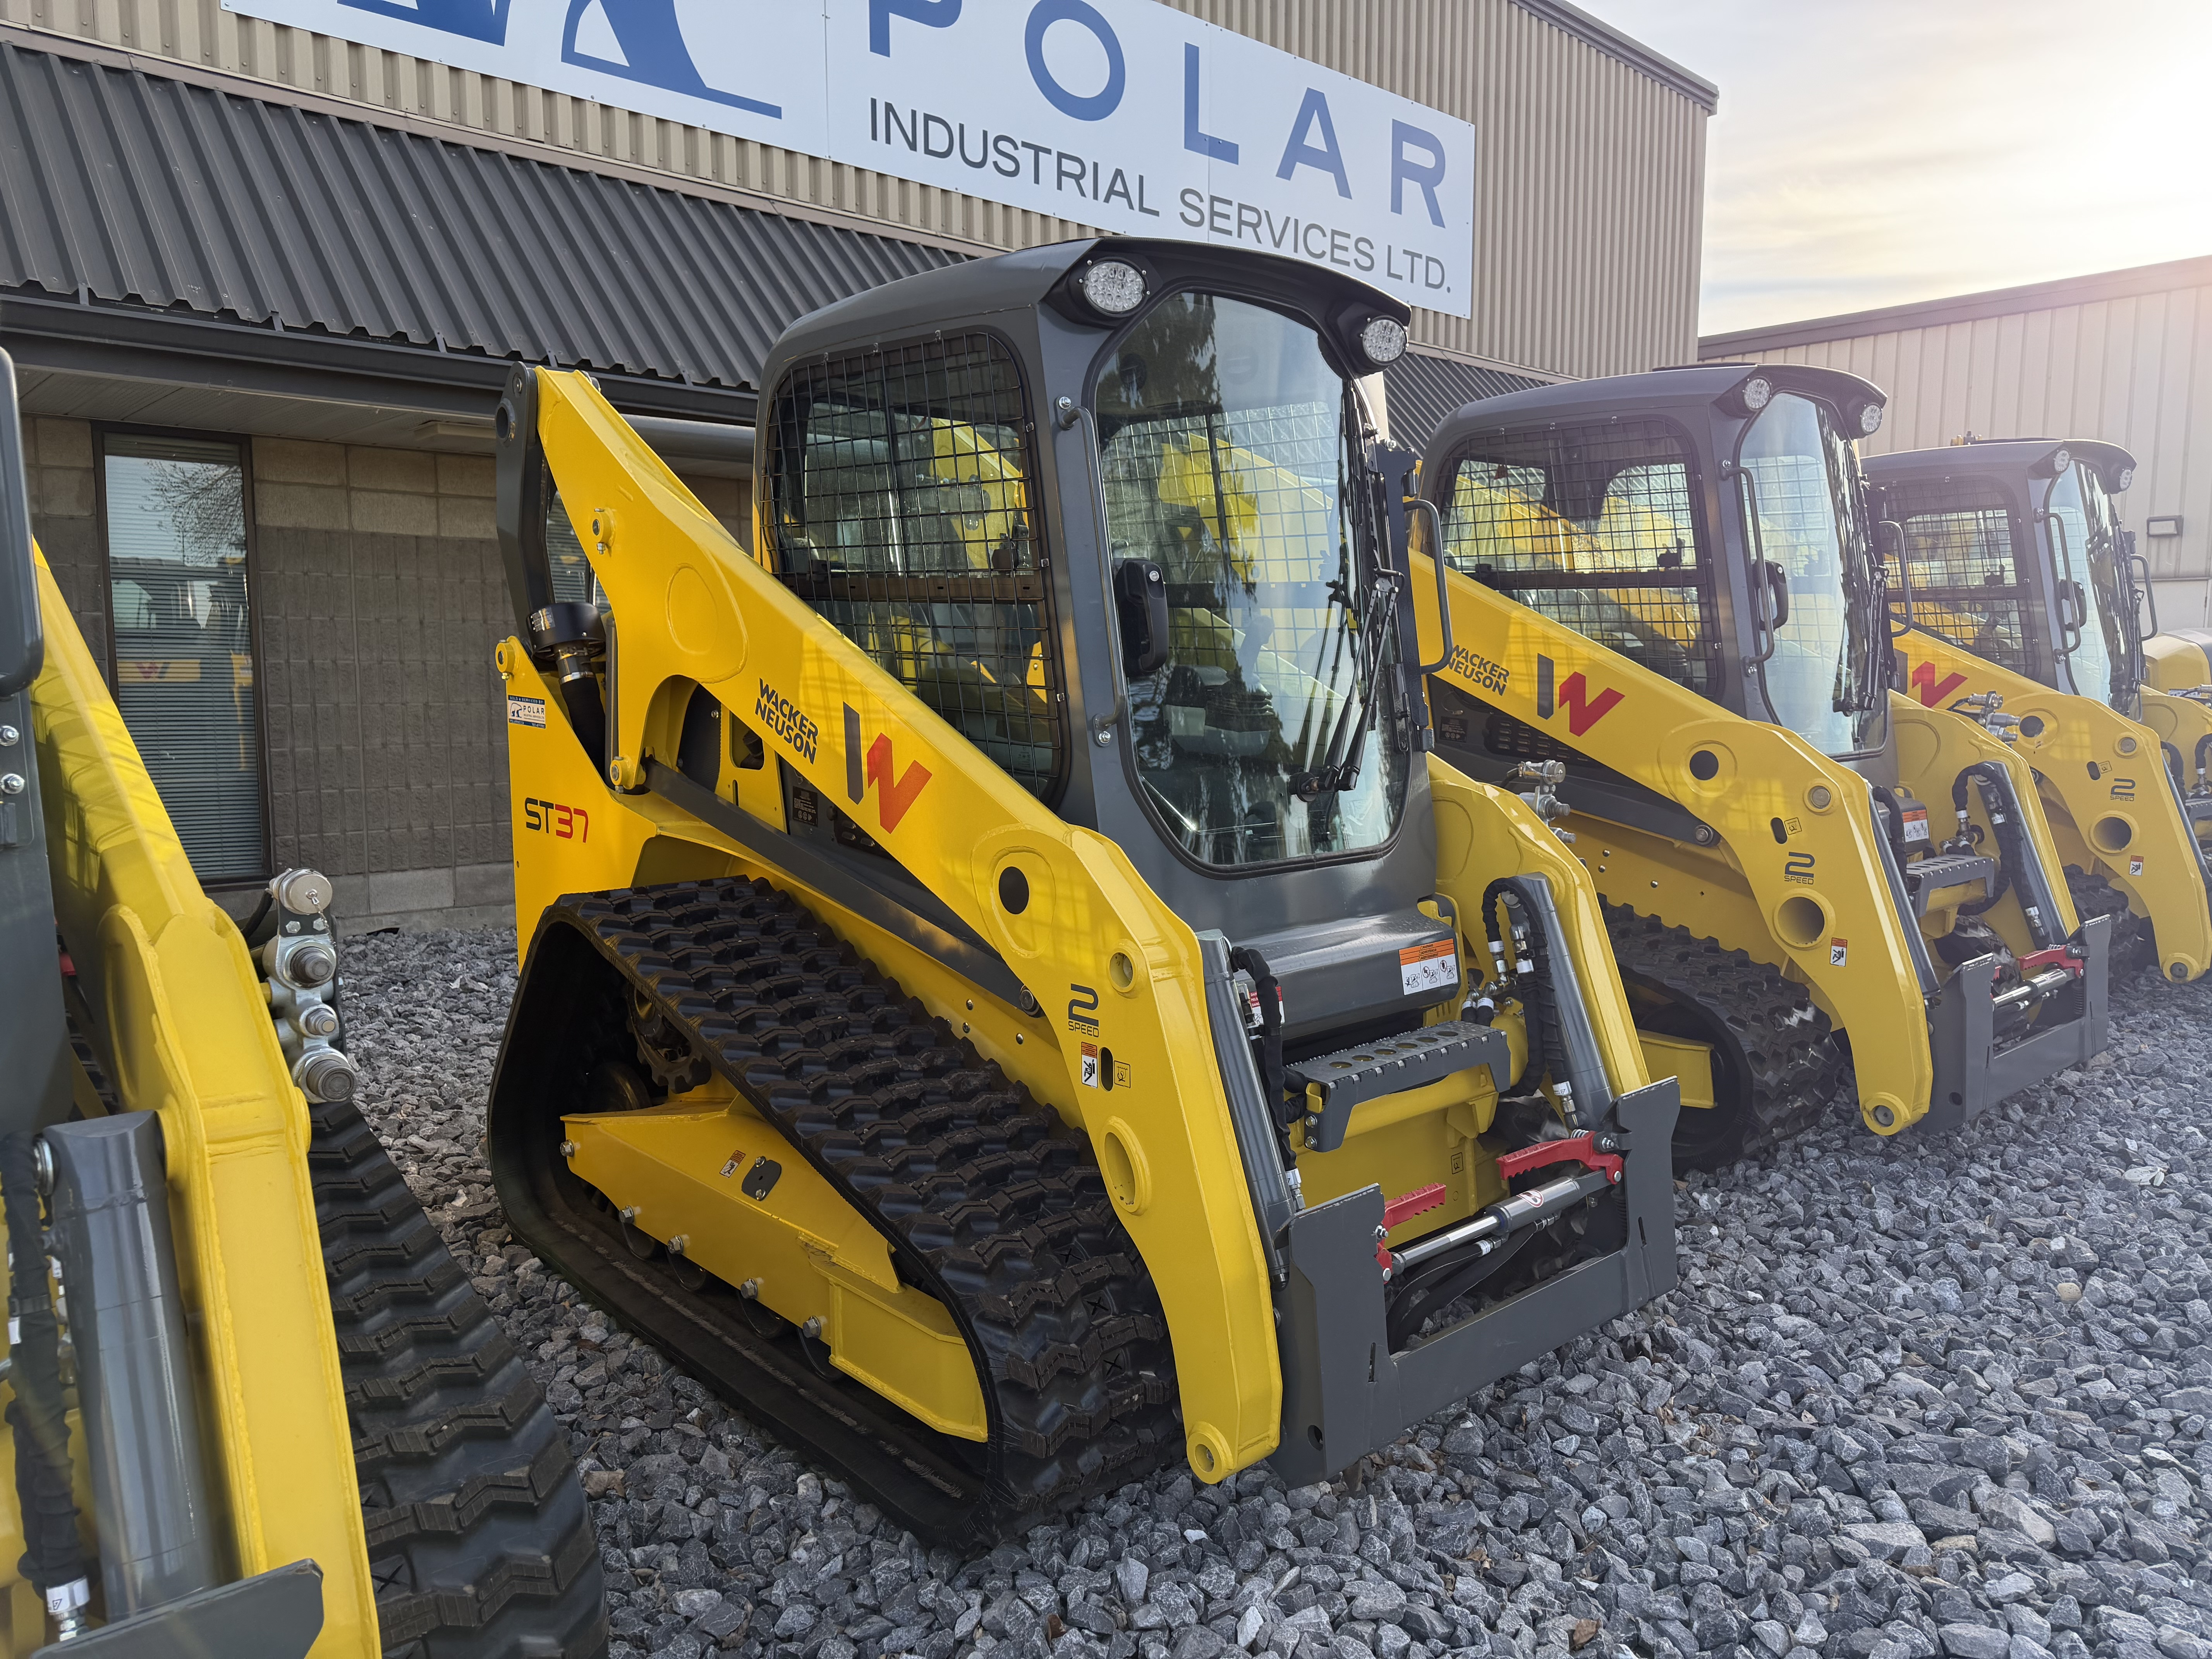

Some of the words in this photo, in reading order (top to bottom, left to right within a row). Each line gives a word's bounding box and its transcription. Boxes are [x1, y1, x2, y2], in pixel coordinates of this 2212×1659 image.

[870, 98, 1159, 217] INDUSTRIAL
[1179, 188, 1375, 272] SERVICES
[1388, 249, 1451, 294] LTD.
[1448, 658, 1506, 696] NEUSON
[1452, 644, 1510, 684] WACKER
[524, 706, 544, 714] POLAR
[759, 677, 818, 746] WACKER
[755, 697, 816, 765] NEUSON
[2111, 778, 2136, 797] 2
[525, 797, 589, 843] ST37
[1784, 875, 1814, 884] SPEED
[1785, 852, 1815, 878] 2
[1068, 983, 1099, 1027] 2
[1068, 1020, 1099, 1037] SPEED
